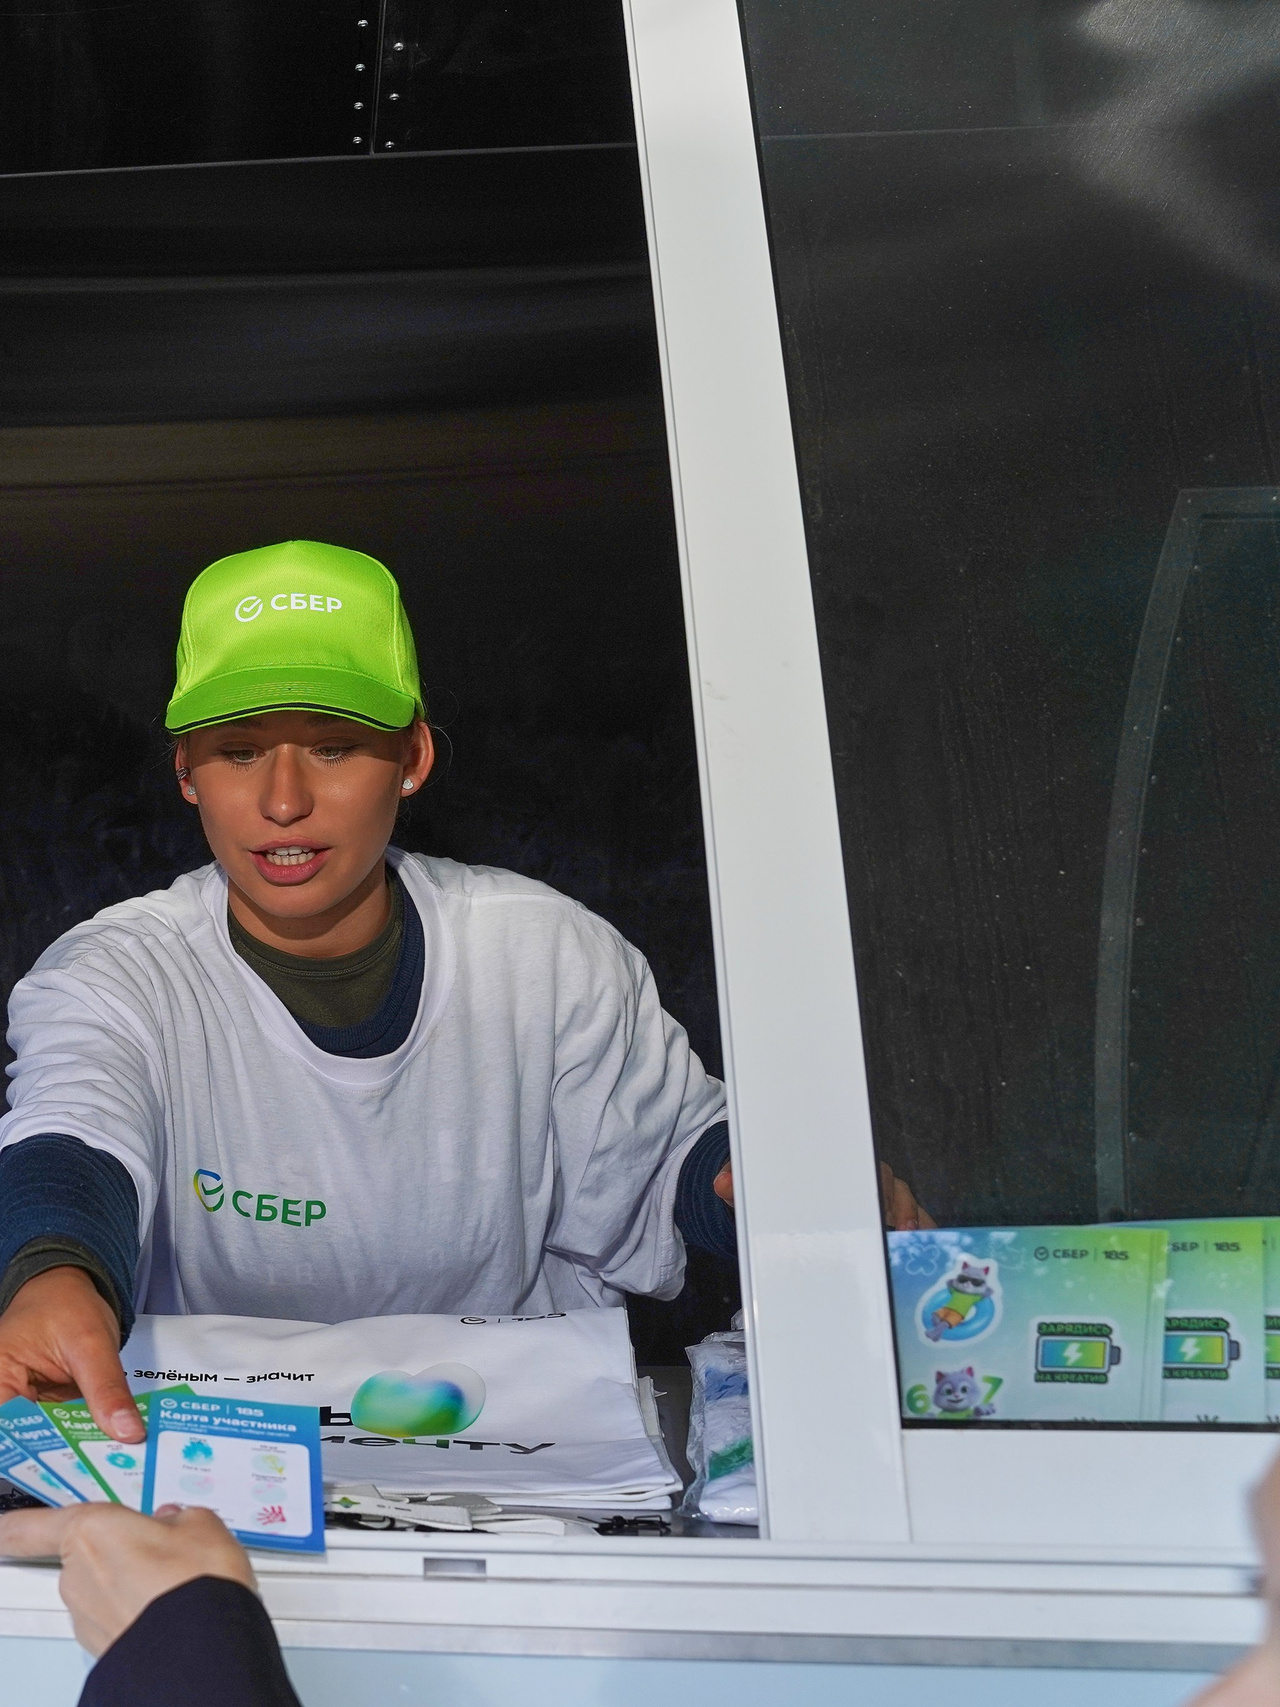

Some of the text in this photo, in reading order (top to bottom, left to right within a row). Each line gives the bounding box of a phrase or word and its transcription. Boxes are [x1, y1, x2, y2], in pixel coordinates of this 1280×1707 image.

[270, 593, 342, 613] СБЕР
[232, 1190, 327, 1227] СБЕР
[1169, 1242, 1240, 1251] БЕР 185
[1052, 1249, 1129, 1260] СБЕР 185
[1039, 1323, 1112, 1336] ЗАРЯДИСЬ
[133, 1369, 218, 1382] зелёным
[246, 1372, 314, 1383] значит
[1036, 1373, 1108, 1384] НА КРЕАТИВ
[906, 1376, 1003, 1414] 6 7
[71, 1409, 90, 1418] СБ
[181, 1401, 264, 1417] СБЕР 185
[13, 1415, 44, 1426] СБЕР
[61, 1420, 98, 1430] Карт
[160, 1409, 209, 1423] Карта
[212, 1416, 296, 1433] участника
[11, 1428, 50, 1440] Карта
